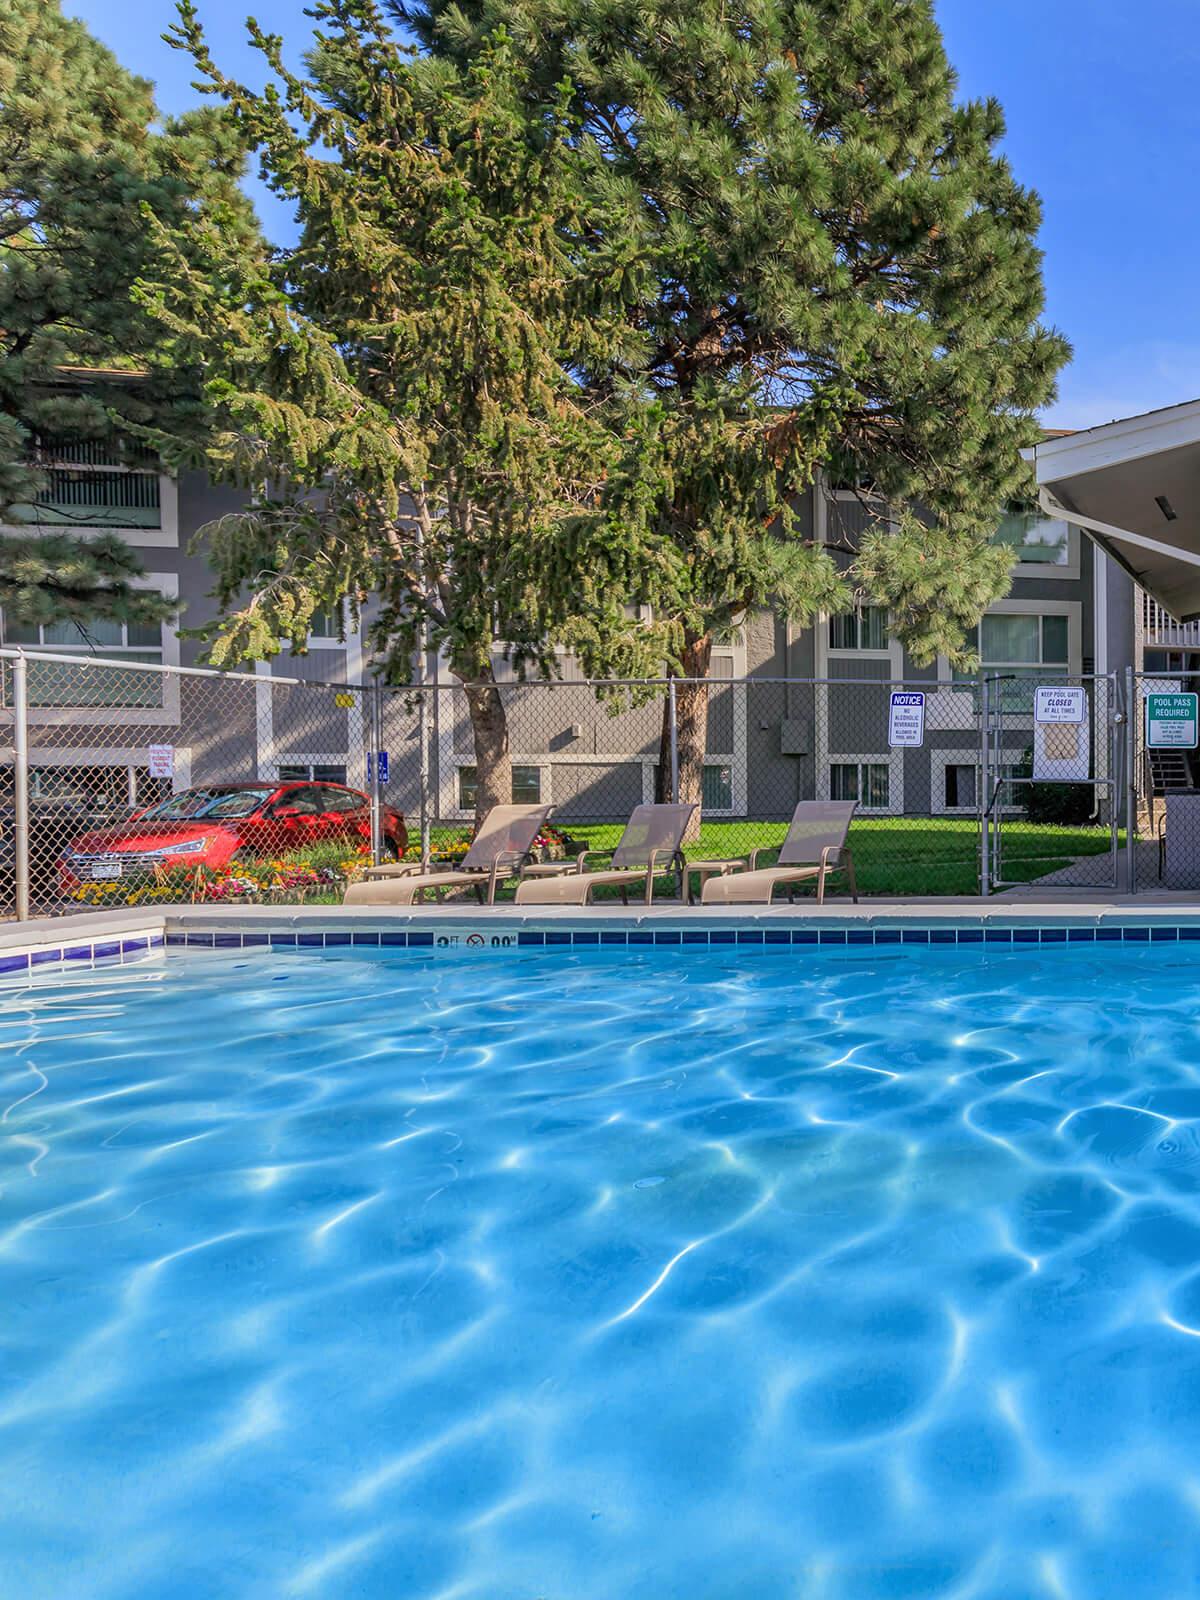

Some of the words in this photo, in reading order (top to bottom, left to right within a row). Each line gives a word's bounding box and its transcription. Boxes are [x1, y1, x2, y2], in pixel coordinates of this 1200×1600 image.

[893, 695, 922, 705] NOTICE
[1047, 698, 1073, 707] CLOSED
[1153, 698, 1171, 706] POOL
[1174, 698, 1191, 706] PASS
[1155, 708, 1190, 717] REQUIRED
